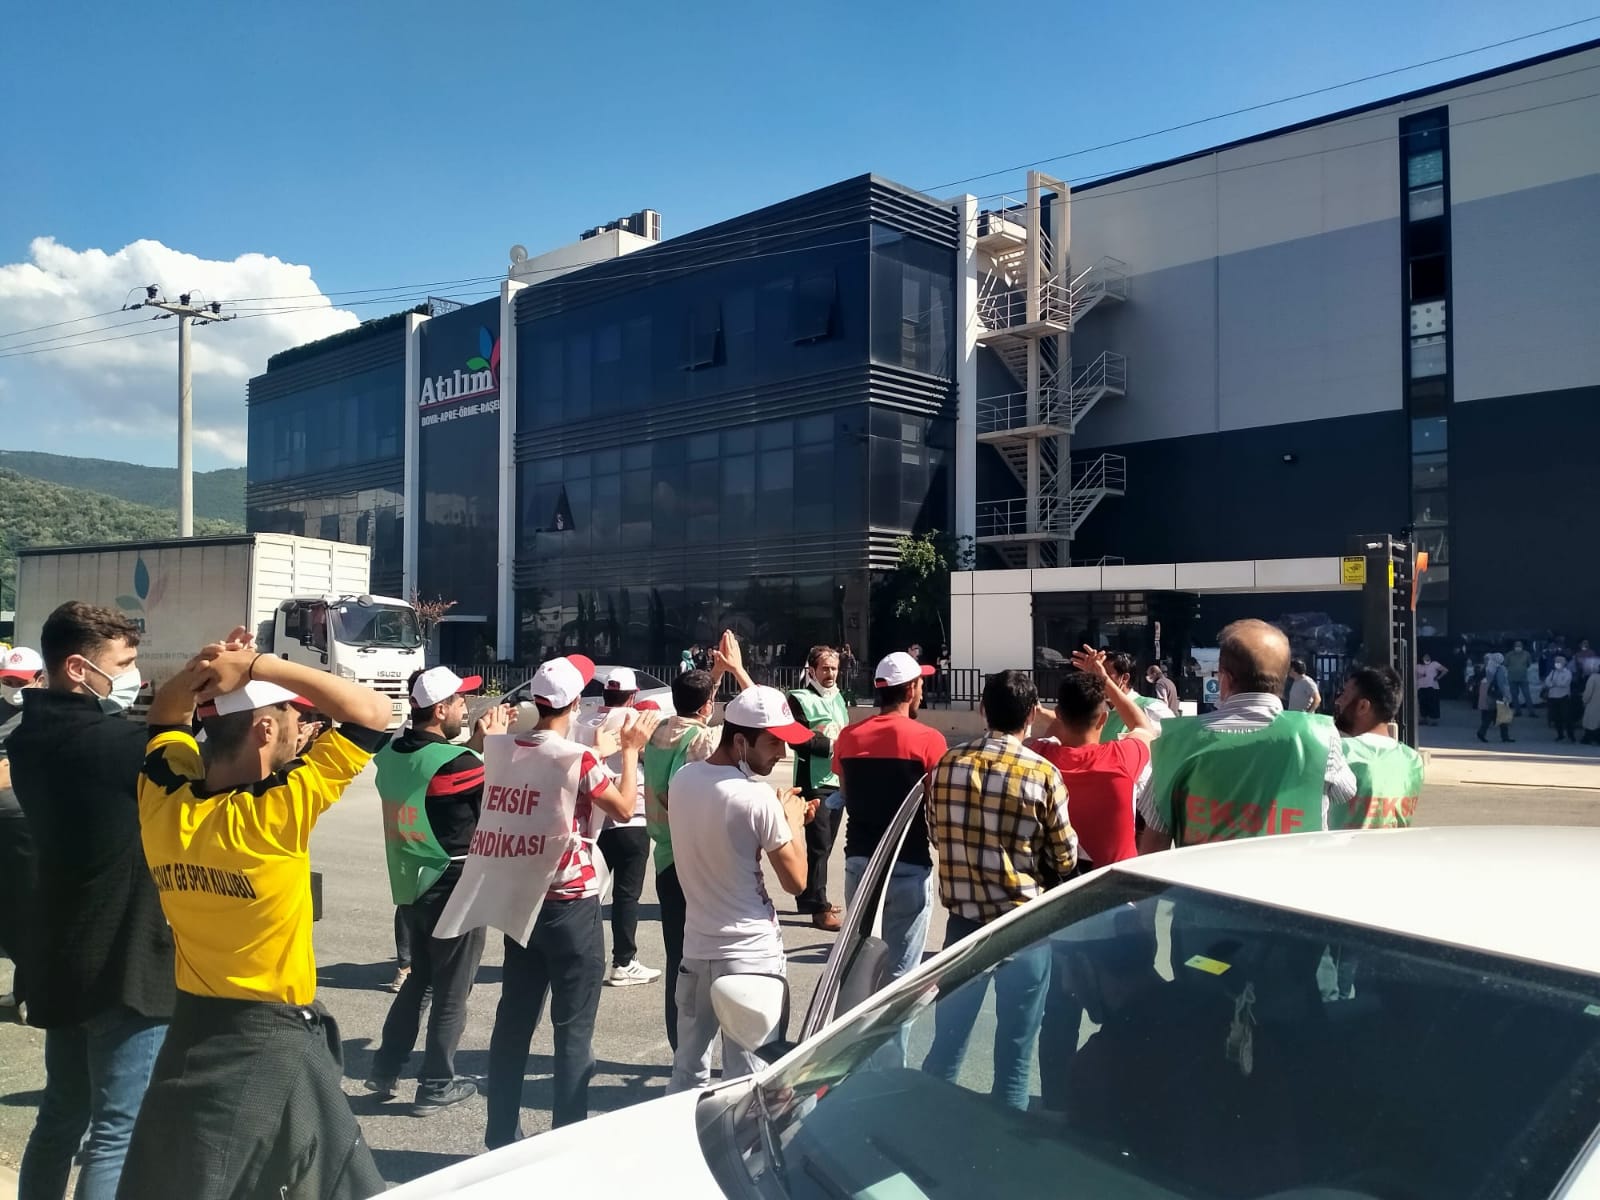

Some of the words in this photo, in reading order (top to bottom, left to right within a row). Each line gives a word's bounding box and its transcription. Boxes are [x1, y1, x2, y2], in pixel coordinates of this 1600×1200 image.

[419, 369, 494, 406] Atılım
[486, 784, 540, 815] EKSİF
[1184, 794, 1304, 836] EKSİF
[174, 863, 188, 891] GB
[186, 864, 212, 893] SPOR
